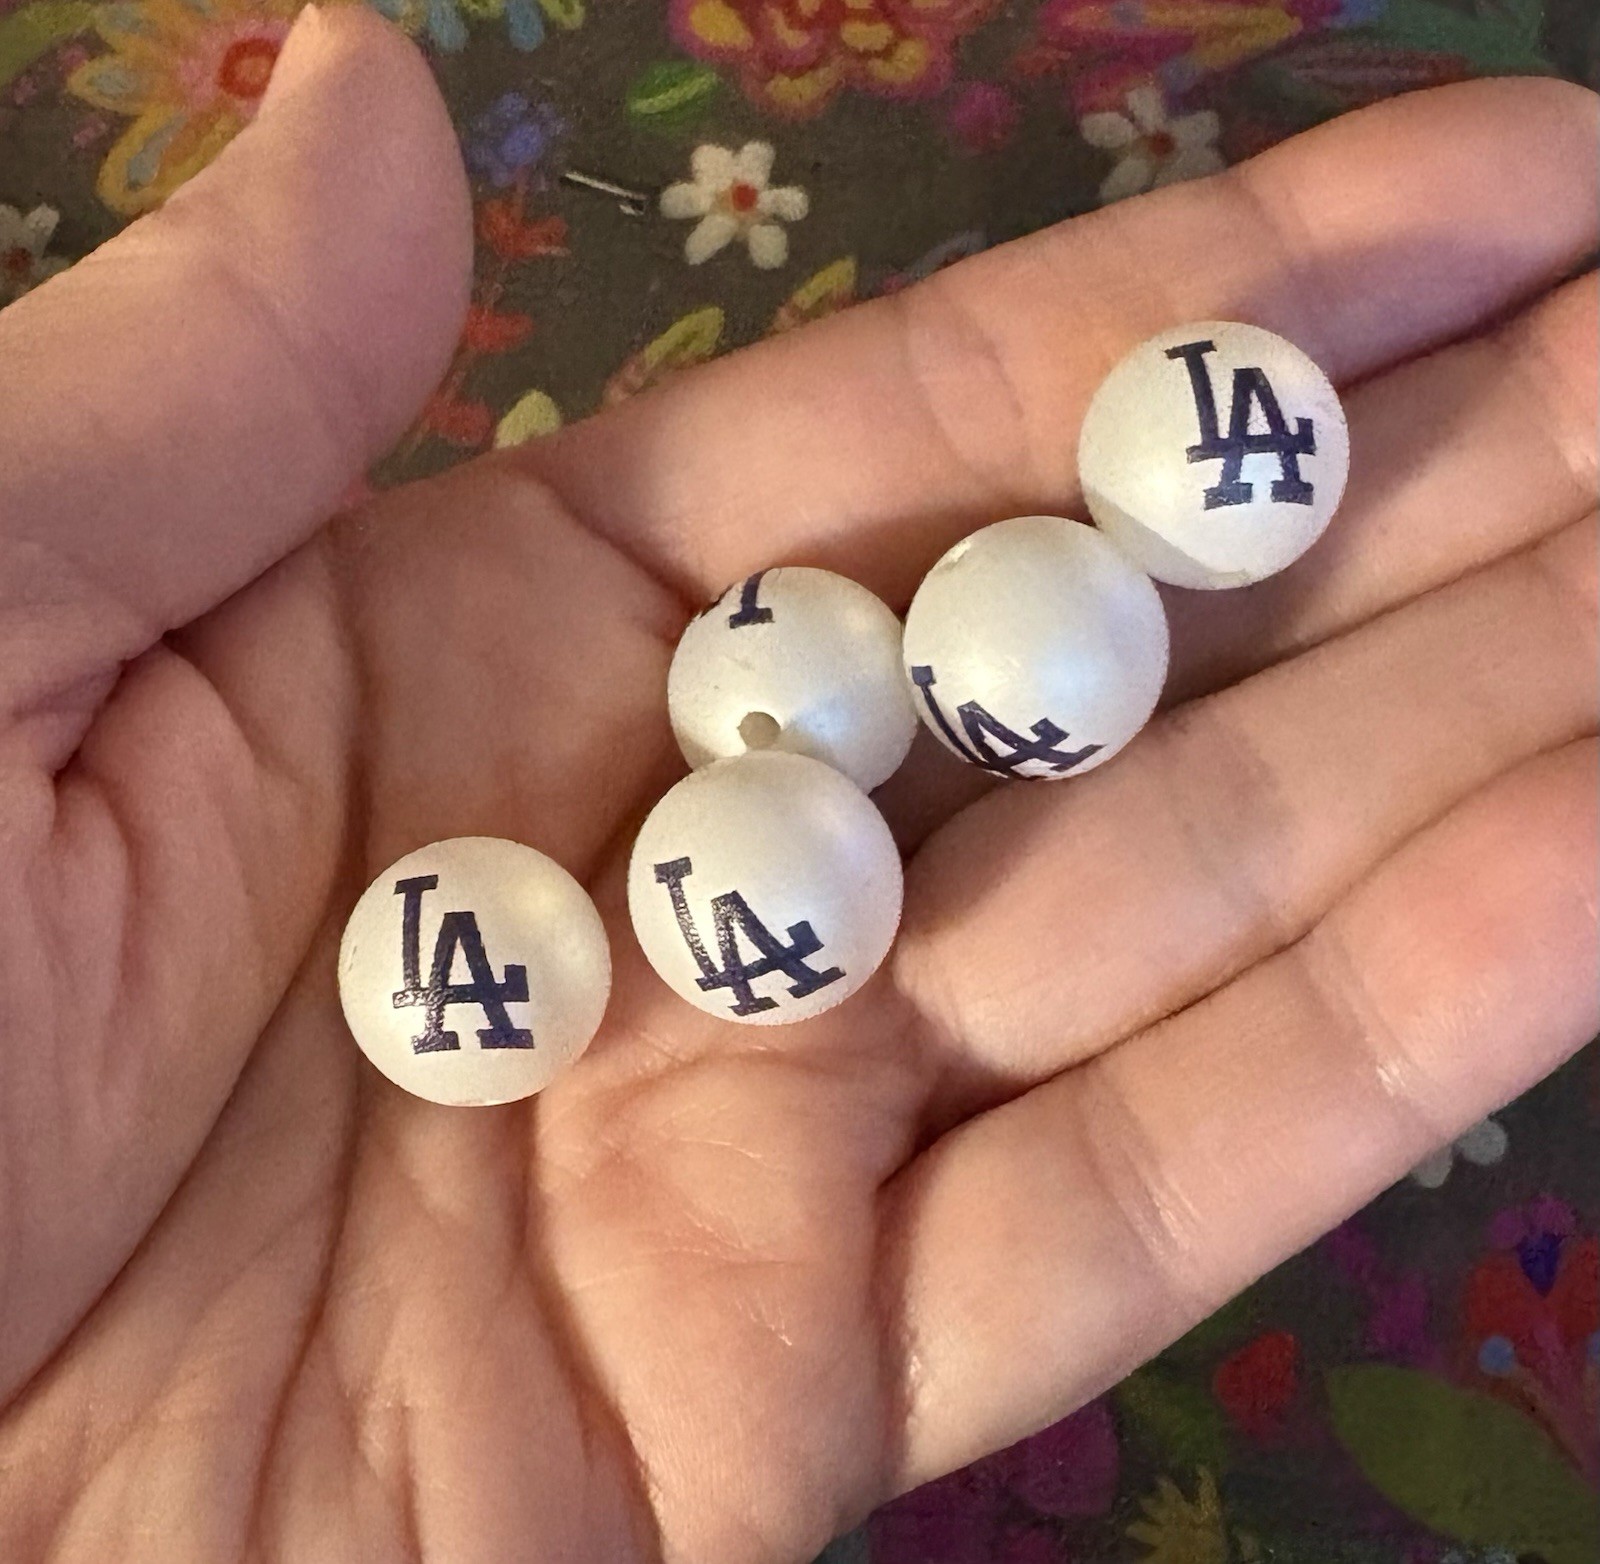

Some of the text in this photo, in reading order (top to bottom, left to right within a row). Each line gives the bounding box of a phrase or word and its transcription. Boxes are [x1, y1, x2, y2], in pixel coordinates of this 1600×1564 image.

[1165, 341, 1316, 509] LA
[393, 875, 535, 1053] LA
[653, 857, 846, 1017] LA
